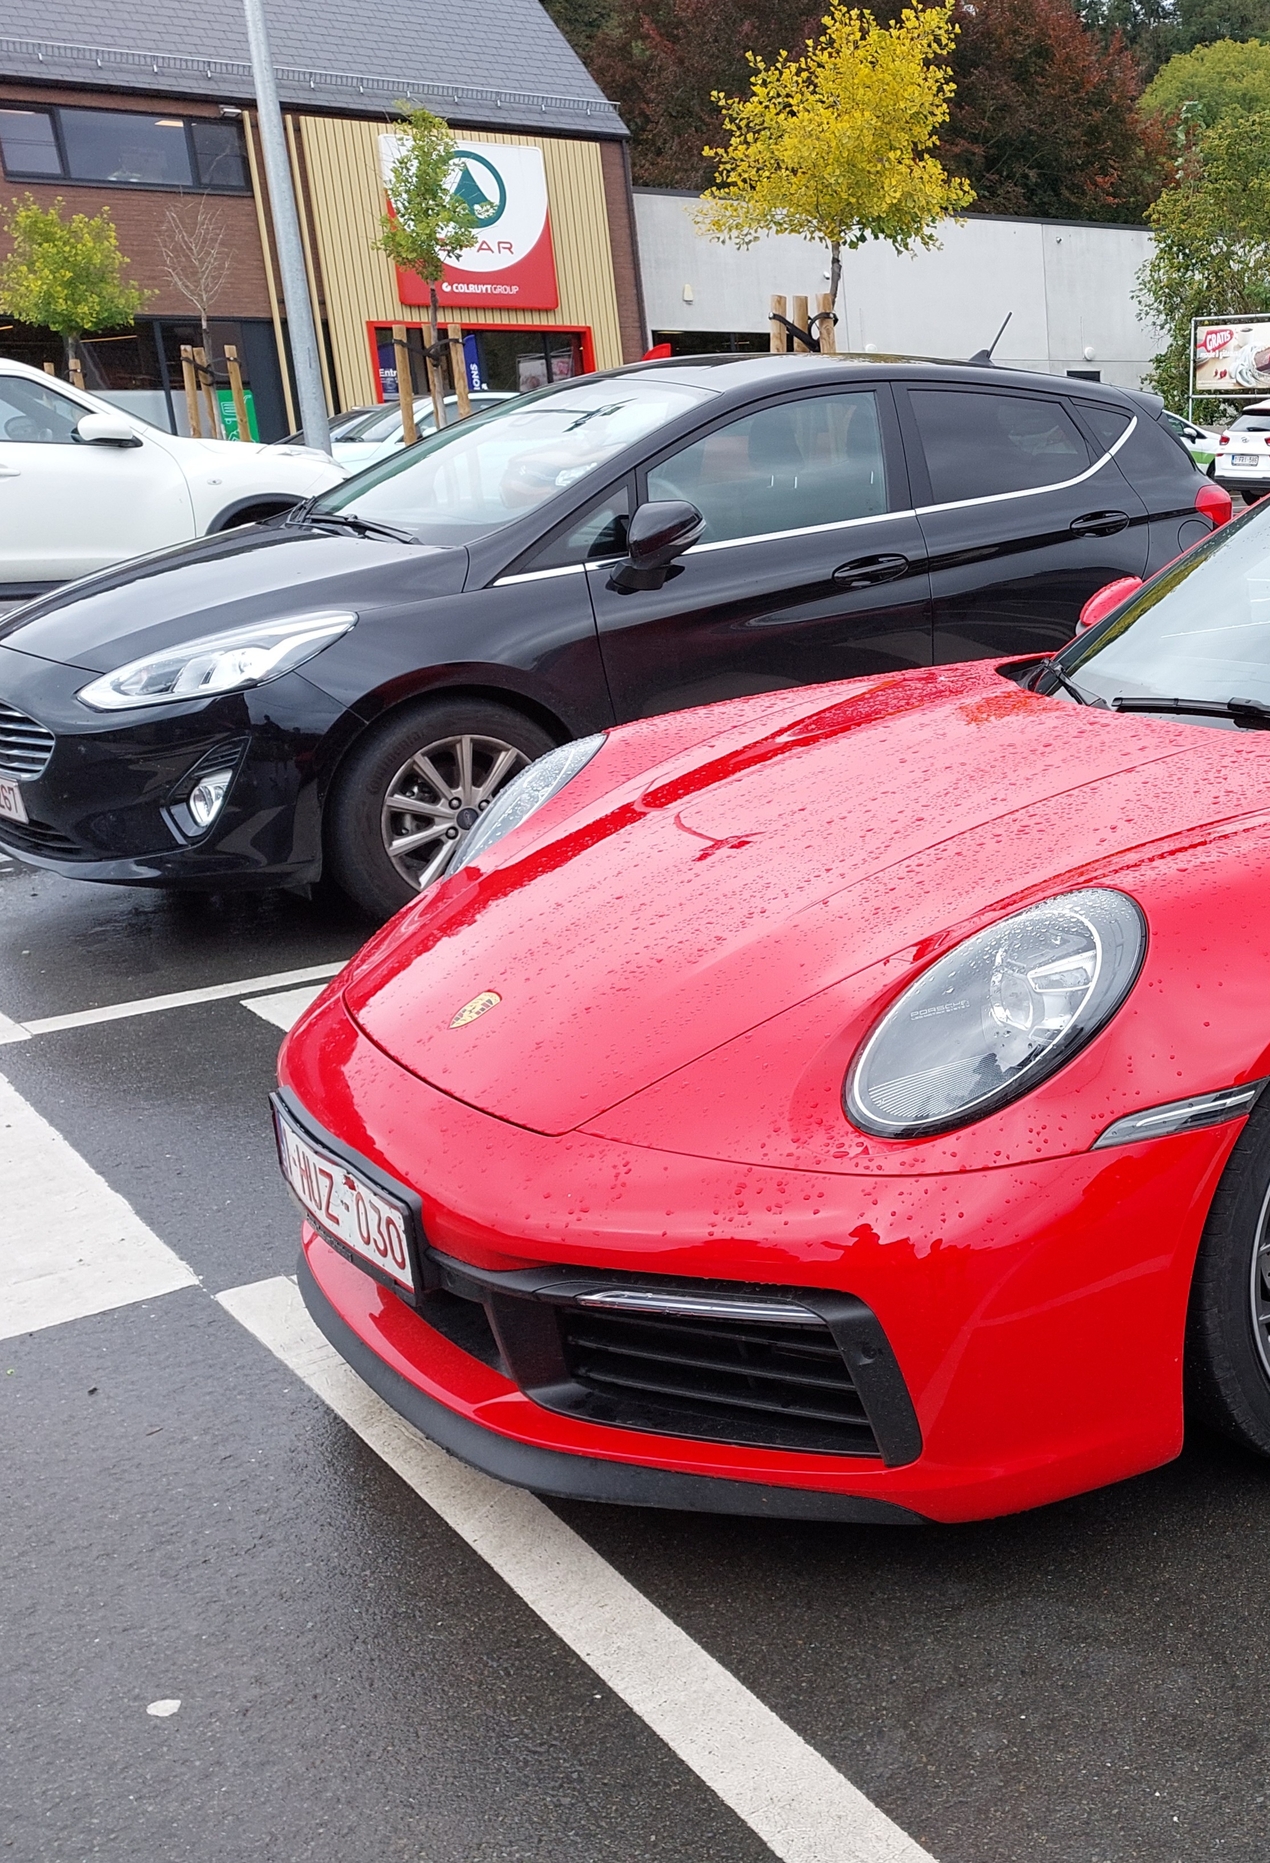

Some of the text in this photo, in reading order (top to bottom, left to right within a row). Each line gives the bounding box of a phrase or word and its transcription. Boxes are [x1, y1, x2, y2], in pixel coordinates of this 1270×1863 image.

[1206, 330, 1231, 350] GRATIS
[379, 368, 397, 377] Entr
[470, 363, 480, 390] IONS
